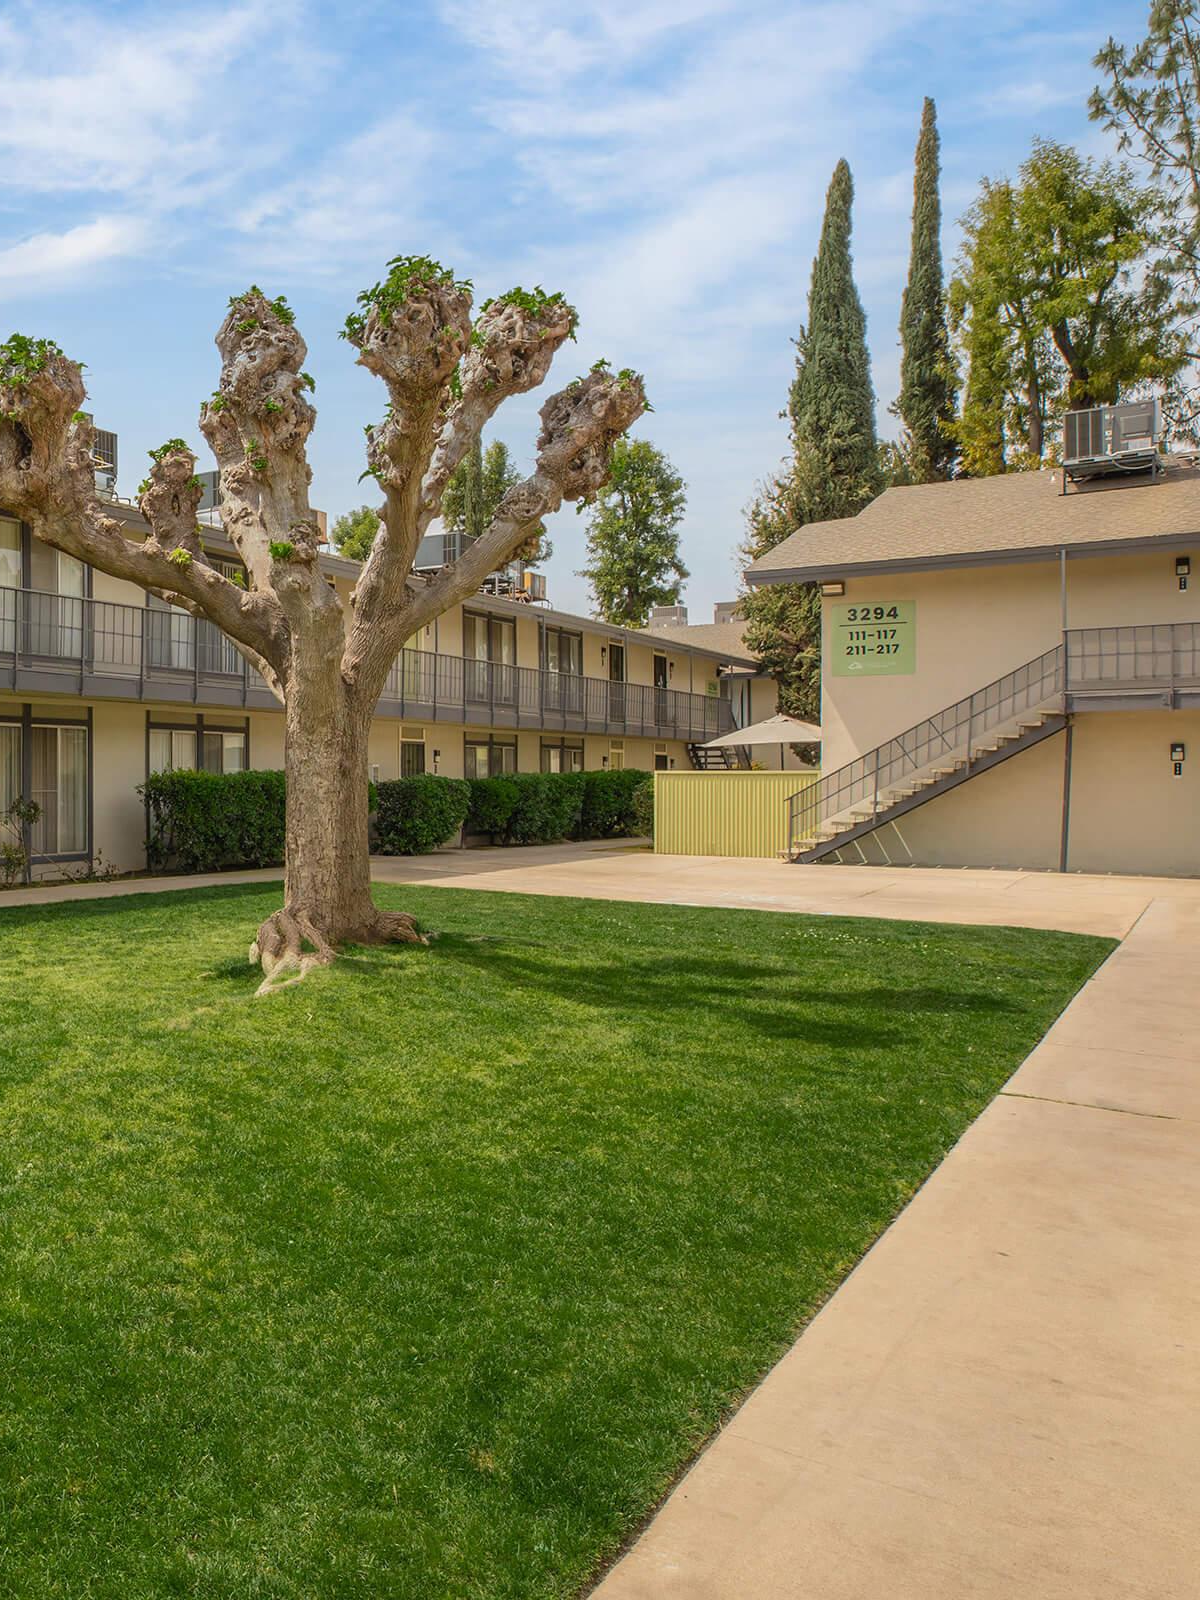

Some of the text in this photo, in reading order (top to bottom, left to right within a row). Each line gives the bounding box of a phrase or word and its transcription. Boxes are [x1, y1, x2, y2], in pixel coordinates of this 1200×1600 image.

[847, 606, 899, 622] 3294
[848, 629, 897, 641] 111-117
[846, 644, 900, 656] 211-217
